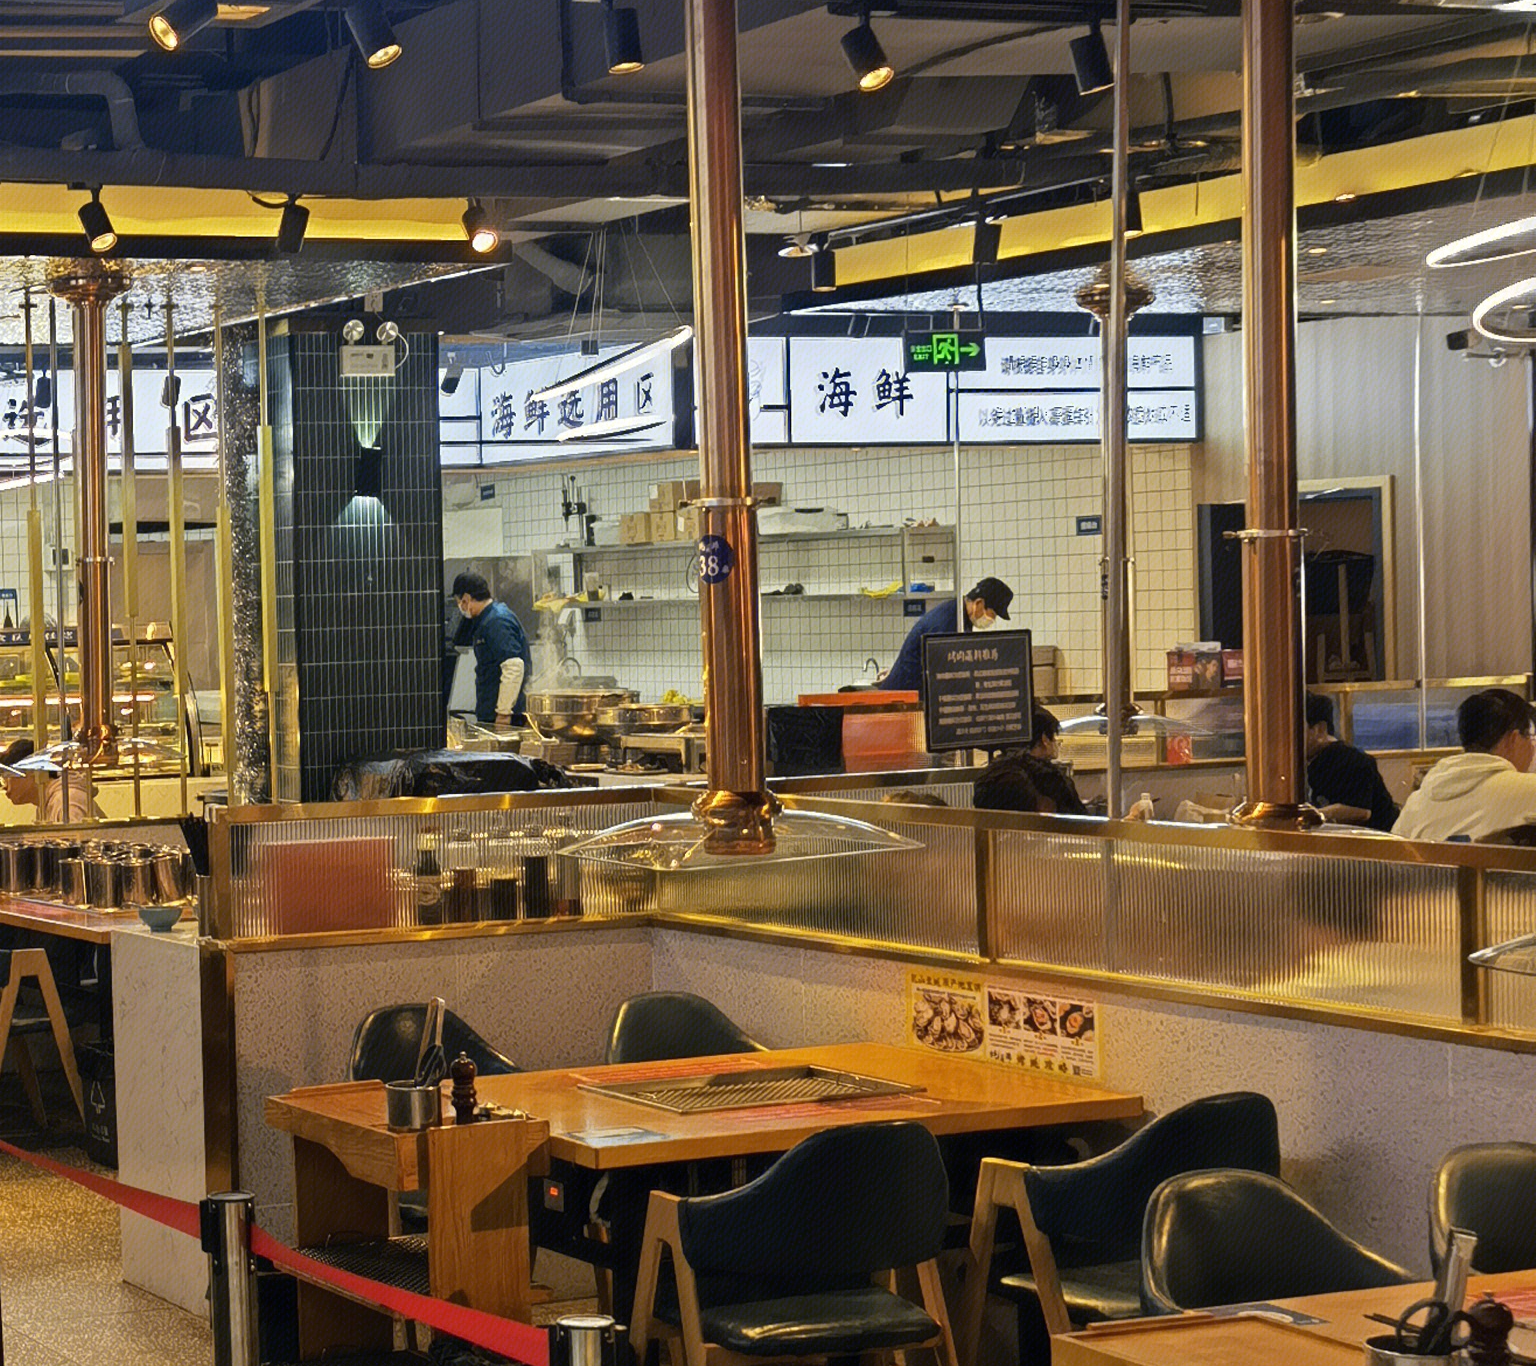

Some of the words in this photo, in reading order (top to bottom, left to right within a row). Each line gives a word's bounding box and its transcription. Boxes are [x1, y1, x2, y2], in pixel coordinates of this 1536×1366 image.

[491, 372, 655, 438] 海鲜选用区
[817, 367, 914, 418] 海鲜
[699, 555, 719, 577] 38
